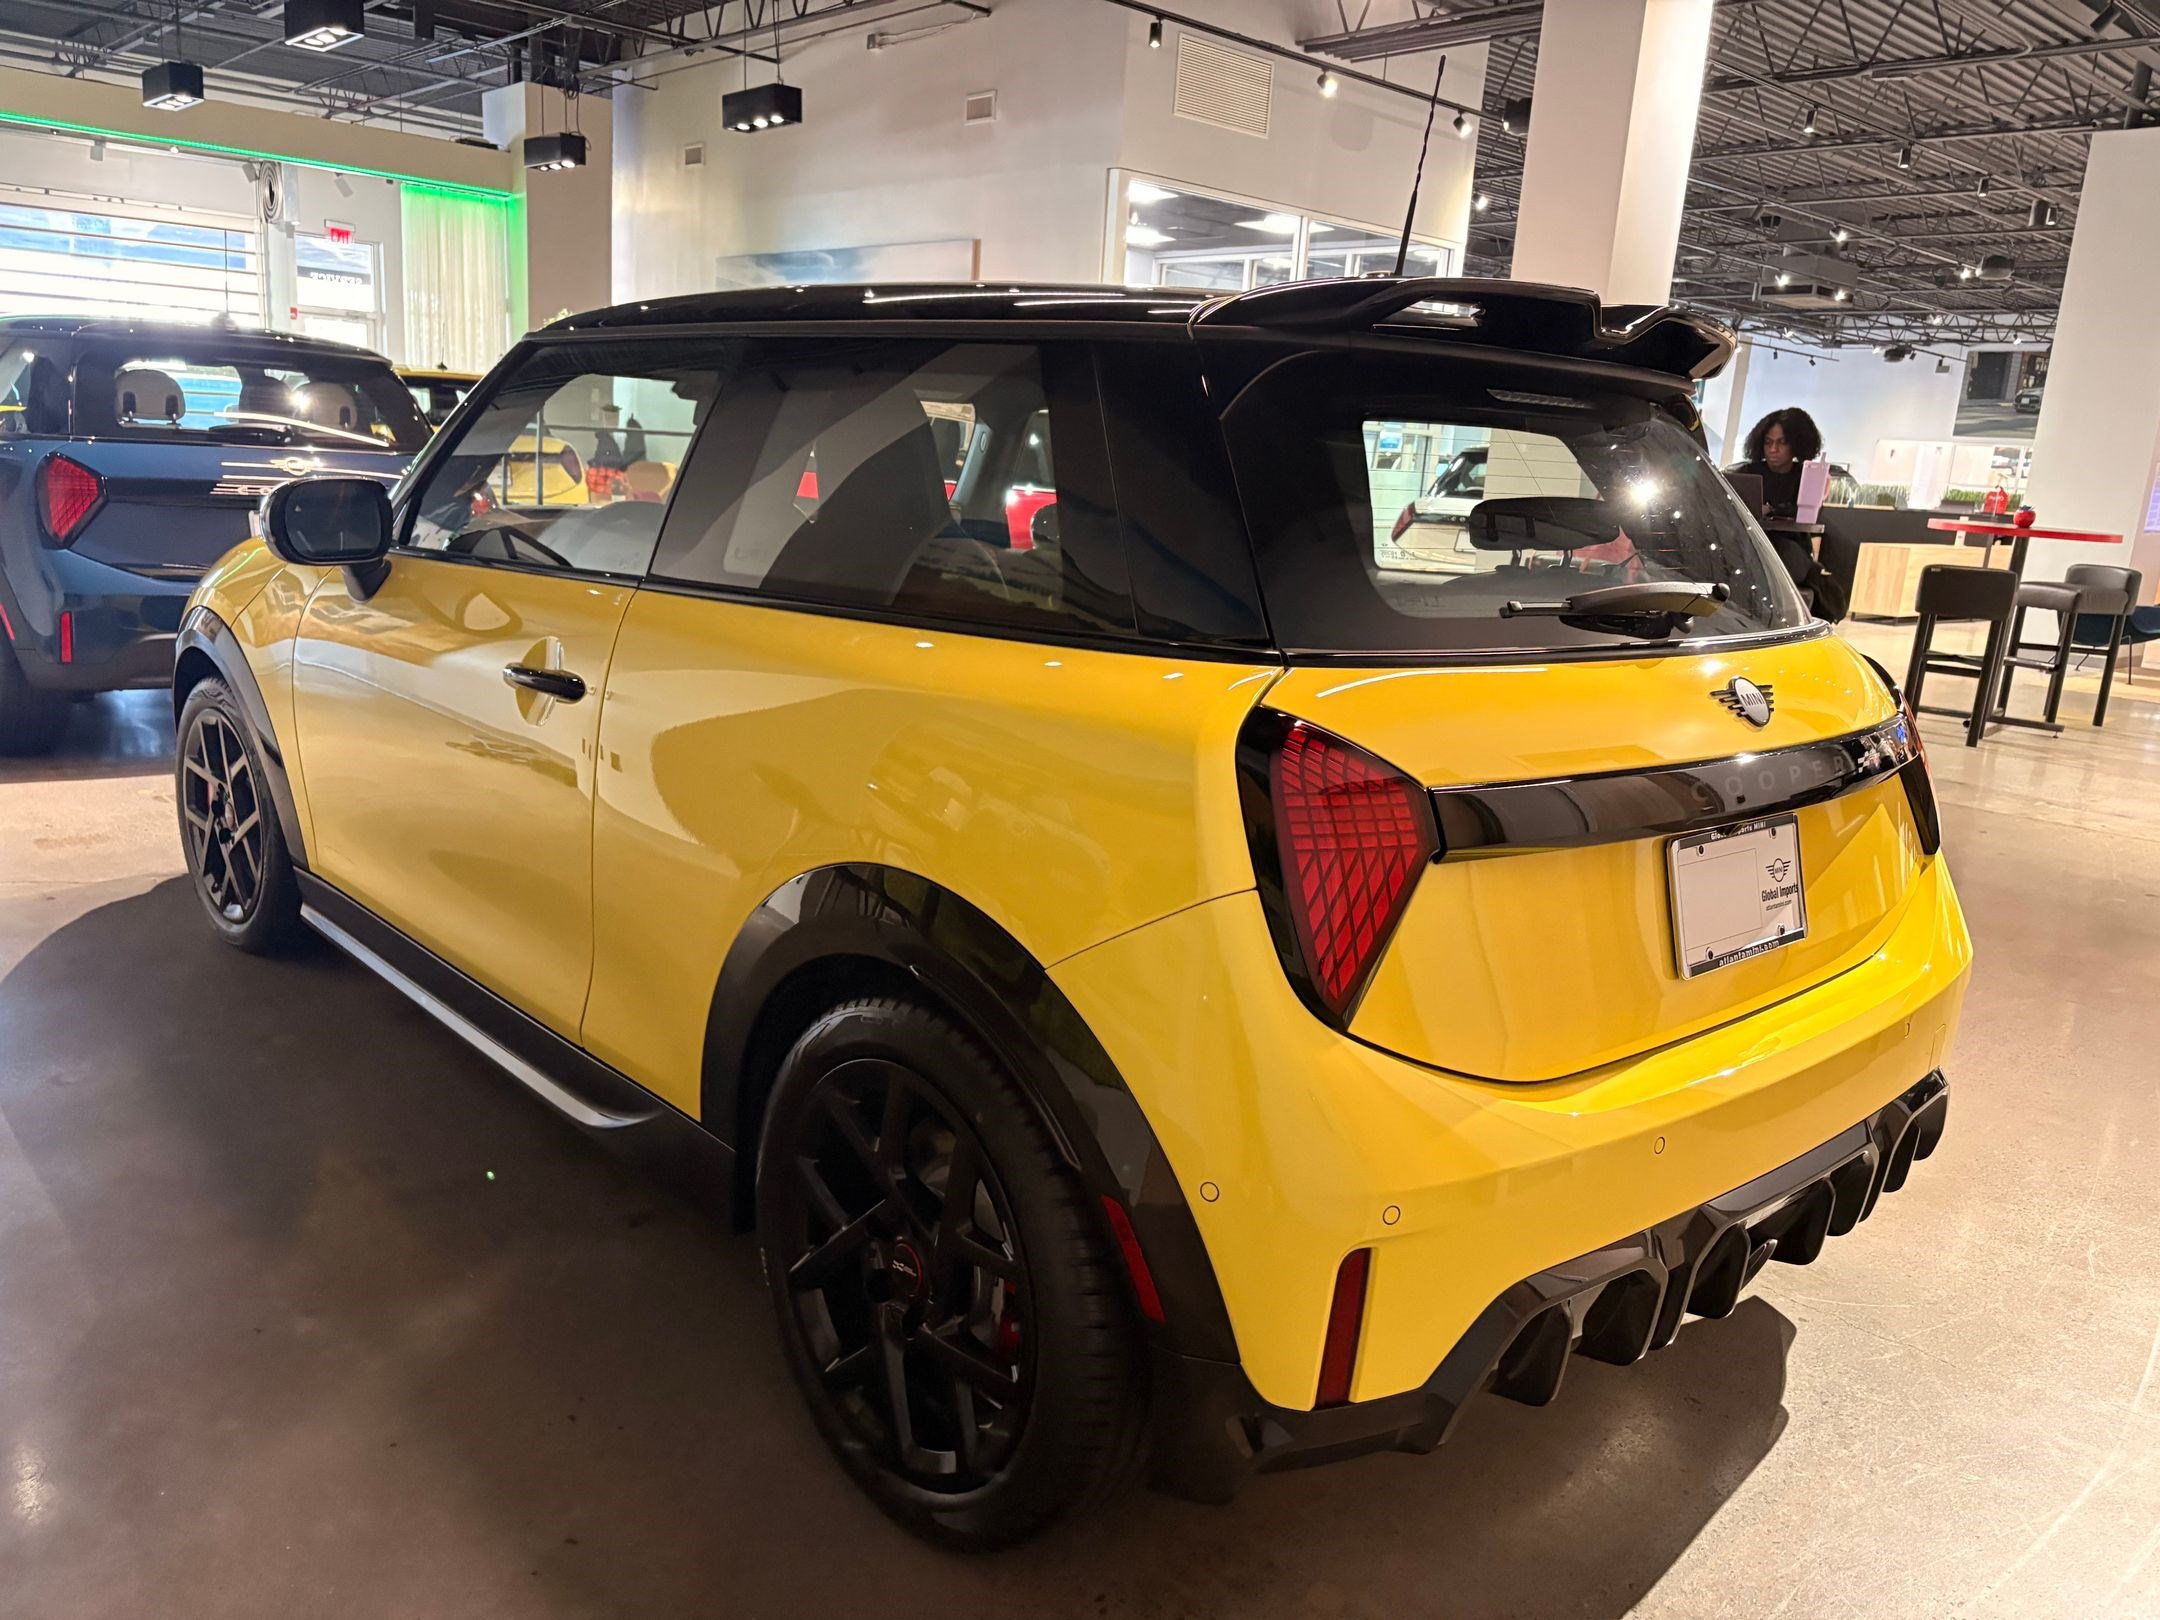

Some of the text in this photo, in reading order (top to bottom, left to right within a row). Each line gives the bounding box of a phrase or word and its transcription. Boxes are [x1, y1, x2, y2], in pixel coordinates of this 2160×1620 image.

[1740, 692, 1766, 706] MINI
[1690, 755, 1847, 804] COOPER
[1761, 883, 1799, 902] Global Imports
[1718, 939, 1780, 967] atlantamini.com
